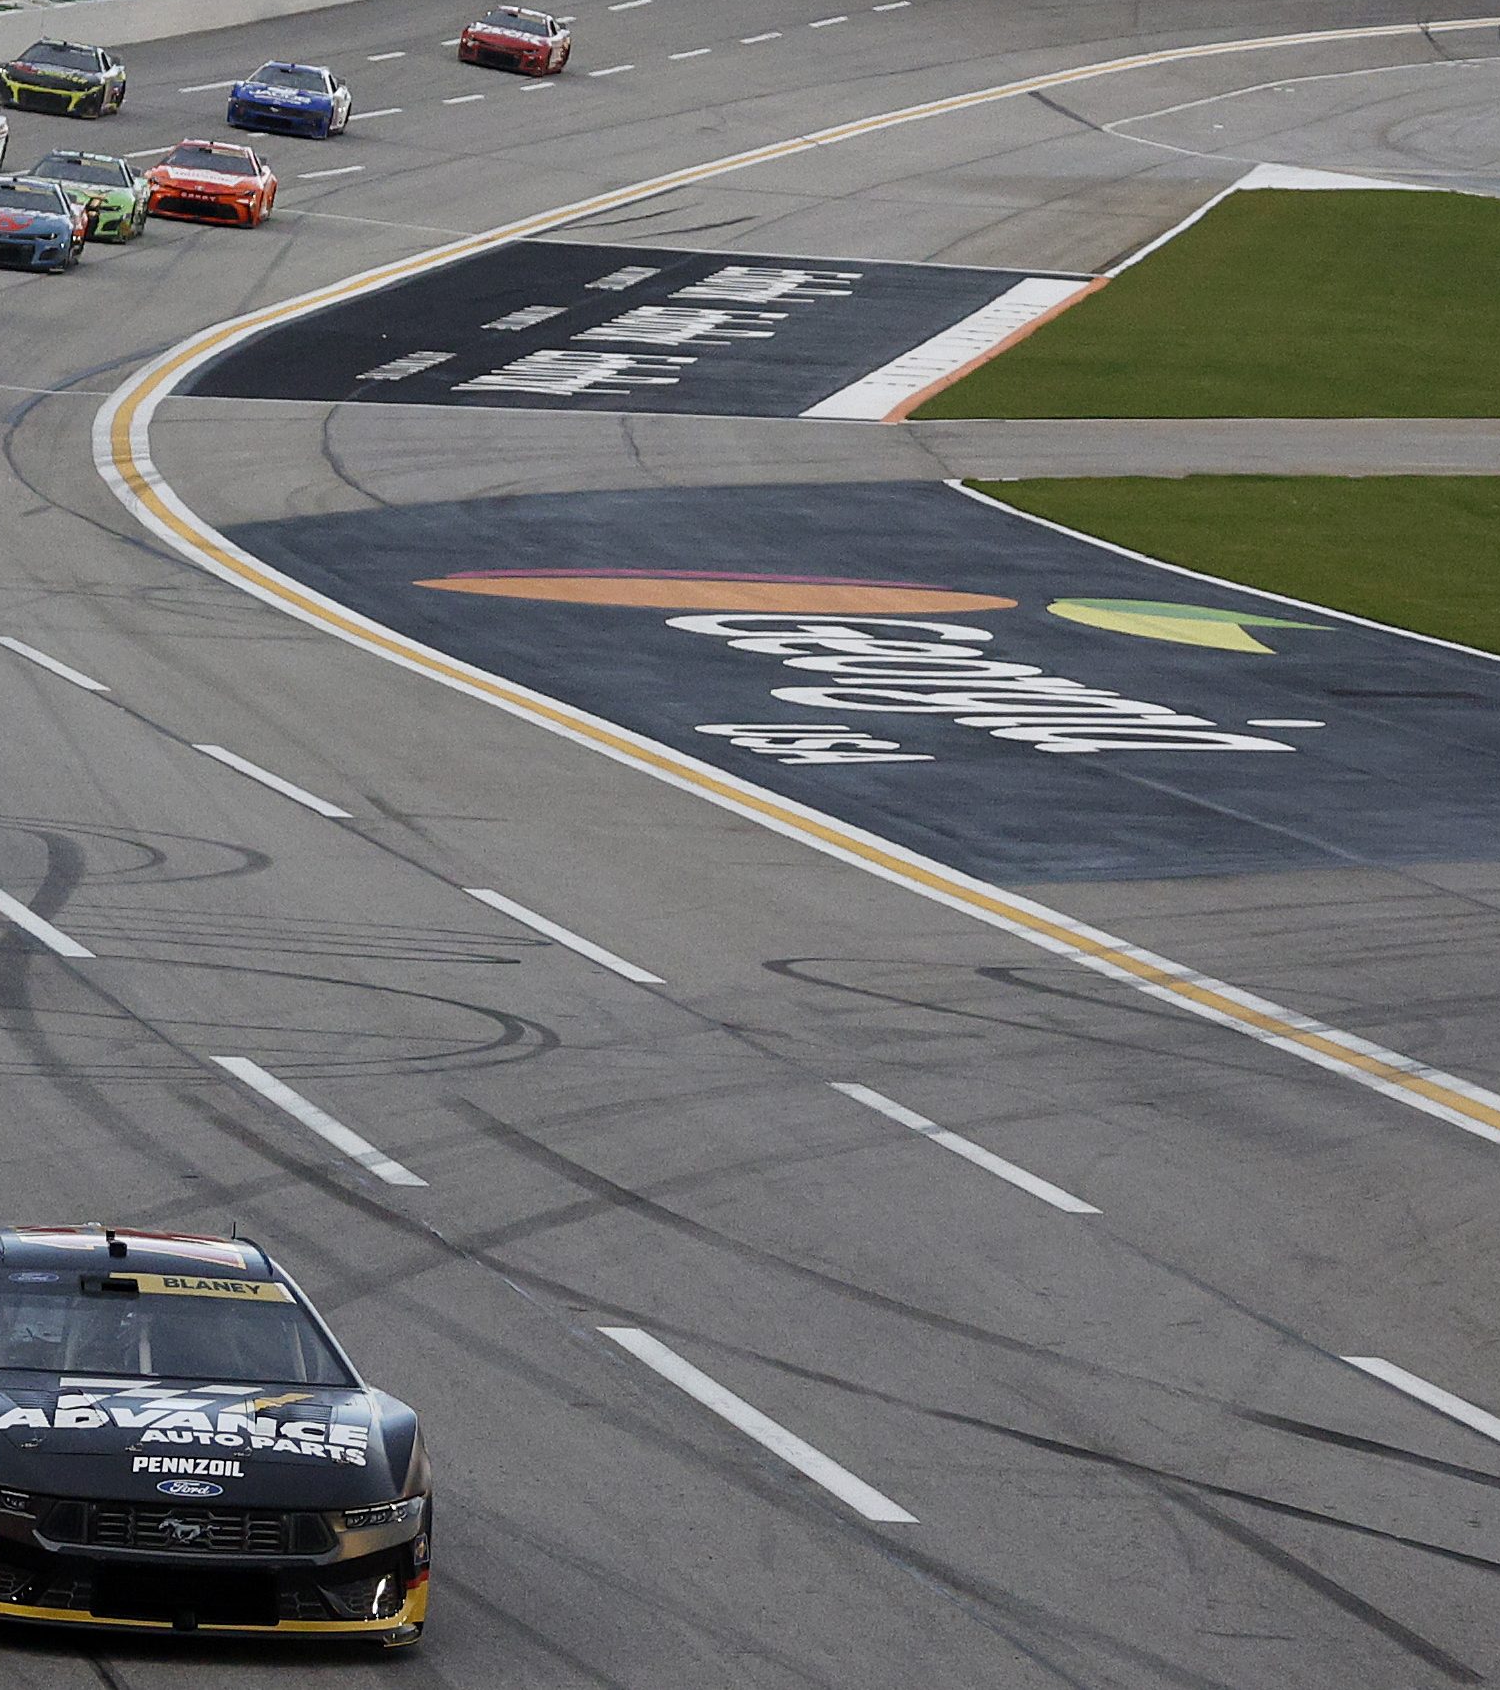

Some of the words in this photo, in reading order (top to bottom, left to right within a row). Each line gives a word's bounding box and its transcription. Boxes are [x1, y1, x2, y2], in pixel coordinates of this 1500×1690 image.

[693, 724, 934, 765] USA
[163, 1277, 262, 1296] BLANEY
[140, 1427, 244, 1447] AUTO
[250, 1432, 367, 1467] PARTS
[132, 1456, 244, 1479] PENNZOIL
[167, 1479, 213, 1496] Ford
